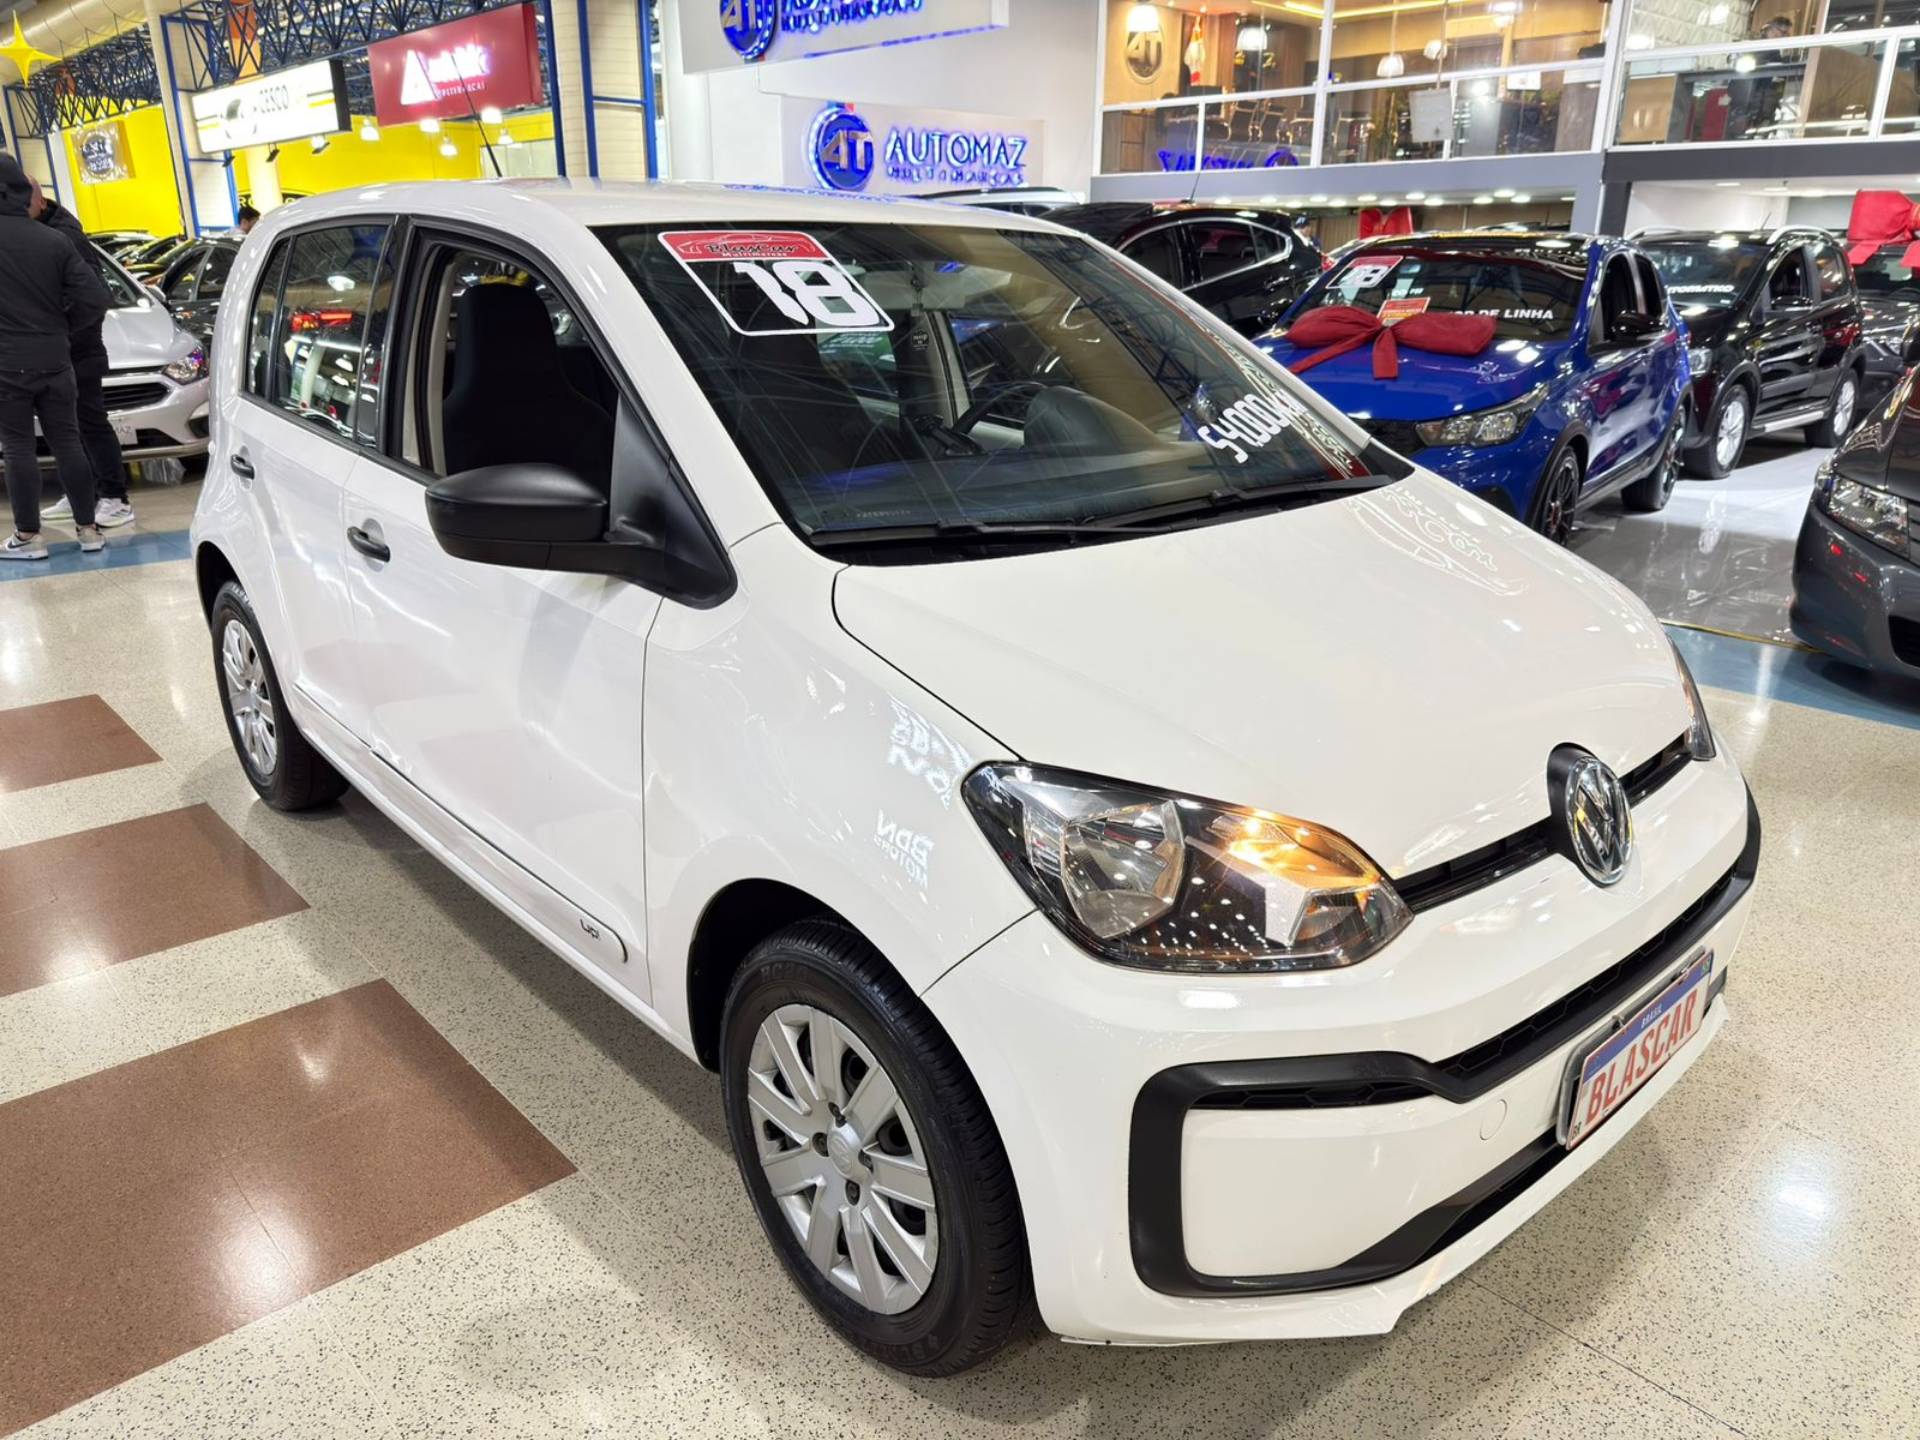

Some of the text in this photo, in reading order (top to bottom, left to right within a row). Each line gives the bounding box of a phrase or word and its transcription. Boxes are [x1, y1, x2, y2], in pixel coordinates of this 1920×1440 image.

[885, 128, 1027, 171] AUTOMAZ
[887, 165, 1024, 187] MULTIMARCAS
[733, 261, 880, 326] 18
[1504, 308, 1554, 319] LINHA
[1586, 989, 1699, 1125] BLASCAR
